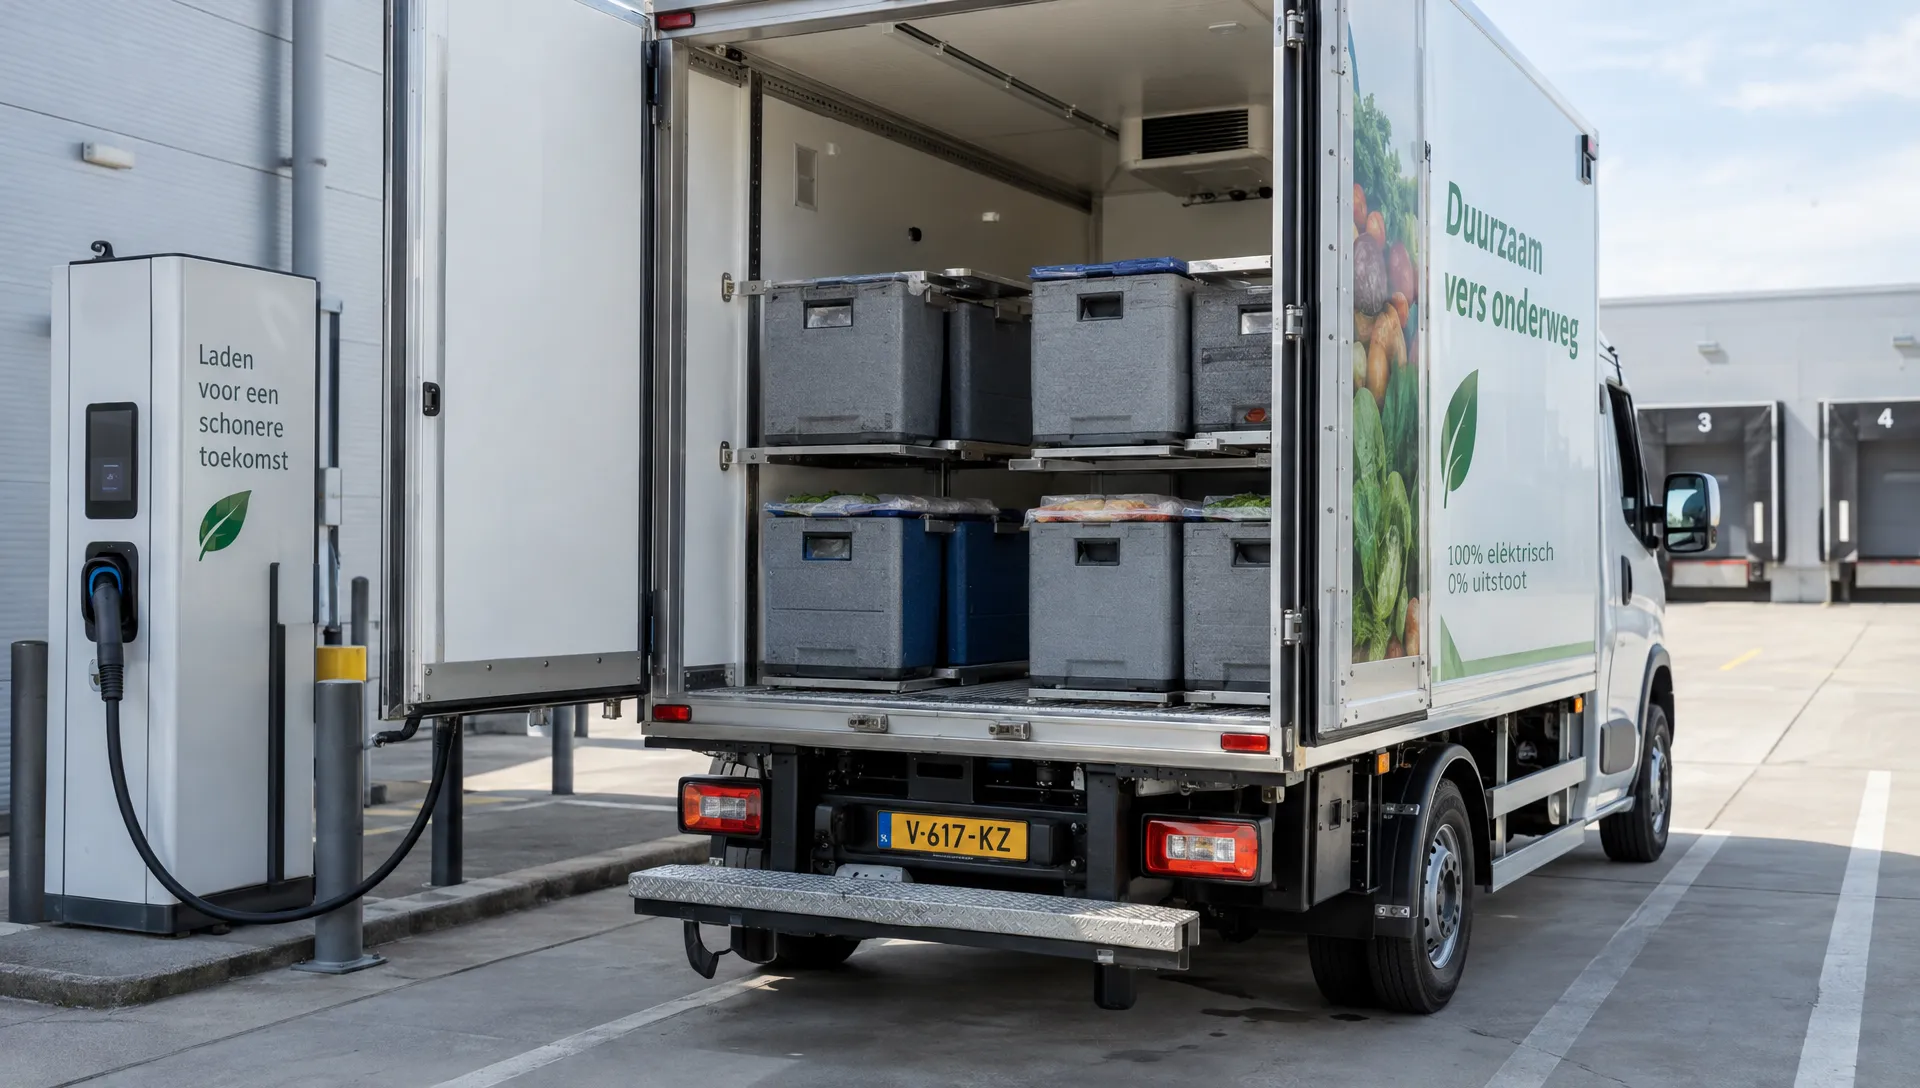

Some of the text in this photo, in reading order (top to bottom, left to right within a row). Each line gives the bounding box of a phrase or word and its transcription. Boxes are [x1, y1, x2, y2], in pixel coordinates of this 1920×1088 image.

[1446, 181, 1542, 275] Duurzaam
[1445, 272, 1579, 360] vers onderweg
[200, 344, 253, 370] Laden
[199, 382, 278, 405] voor een
[199, 412, 283, 438] schonere
[1697, 412, 1712, 433] 3
[1877, 407, 1894, 429] 4
[199, 446, 288, 471] toekomst
[1448, 544, 1483, 566] 100%
[1448, 570, 1527, 594] 0% uitstoot
